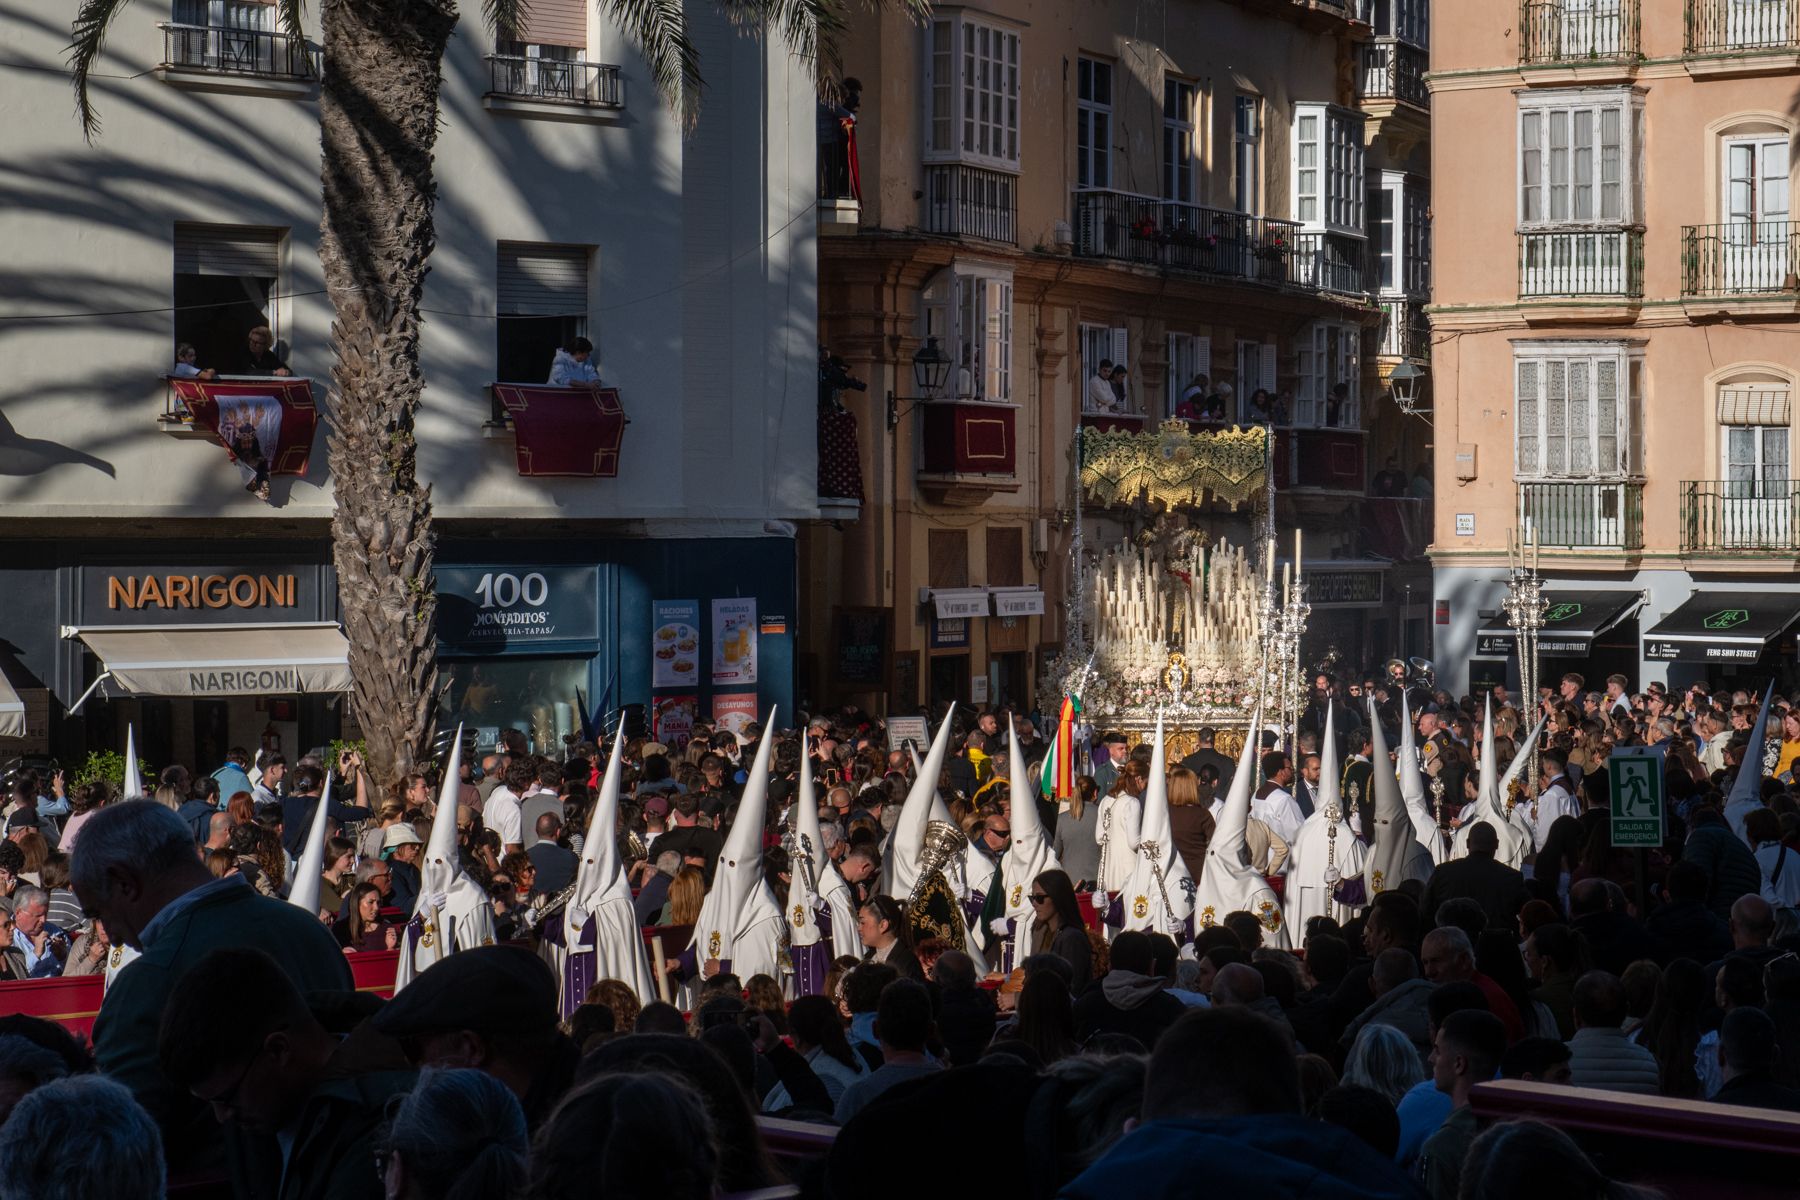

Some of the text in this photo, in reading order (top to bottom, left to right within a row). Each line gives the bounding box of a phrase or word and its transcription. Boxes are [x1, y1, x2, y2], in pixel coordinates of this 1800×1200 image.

[109, 575, 295, 608] NARIGONI
[474, 572, 549, 609] 100
[659, 607, 693, 615] RACIONES
[720, 606, 750, 614] HELADAS
[1537, 642, 1551, 650] FENG
[1566, 643, 1587, 651] STREET
[1707, 648, 1757, 658] FENG SHUI STREET
[189, 670, 295, 691] NARIGONI
[717, 701, 754, 709] DESAYUNOS
[1618, 823, 1654, 831] SALIDA DE
[1615, 832, 1658, 841] EMERGENCIA
